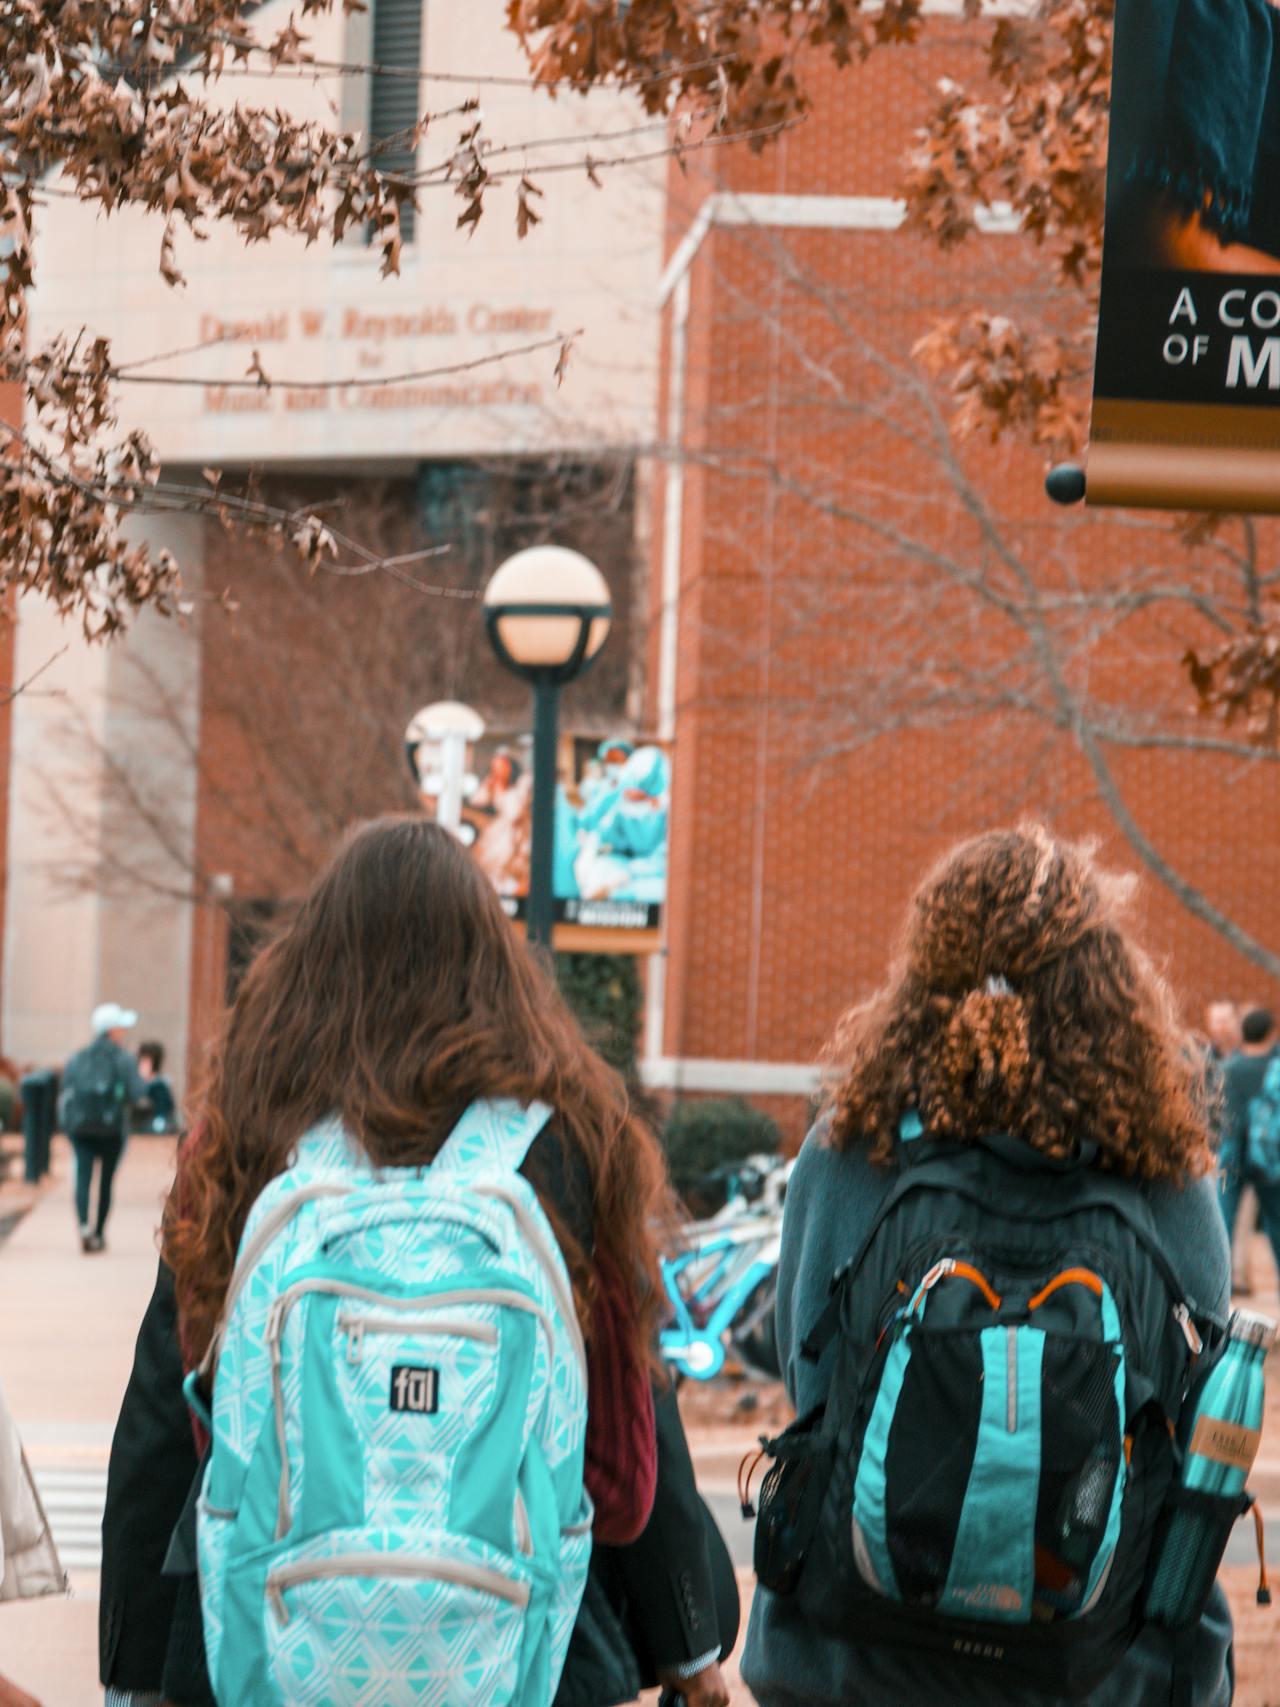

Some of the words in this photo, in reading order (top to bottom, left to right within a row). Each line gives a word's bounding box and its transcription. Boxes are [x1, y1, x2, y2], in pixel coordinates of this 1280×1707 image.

[466, 301, 553, 334] Center
[1169, 286, 1198, 326] A
[1218, 288, 1280, 330] CO
[1162, 333, 1210, 367] OF
